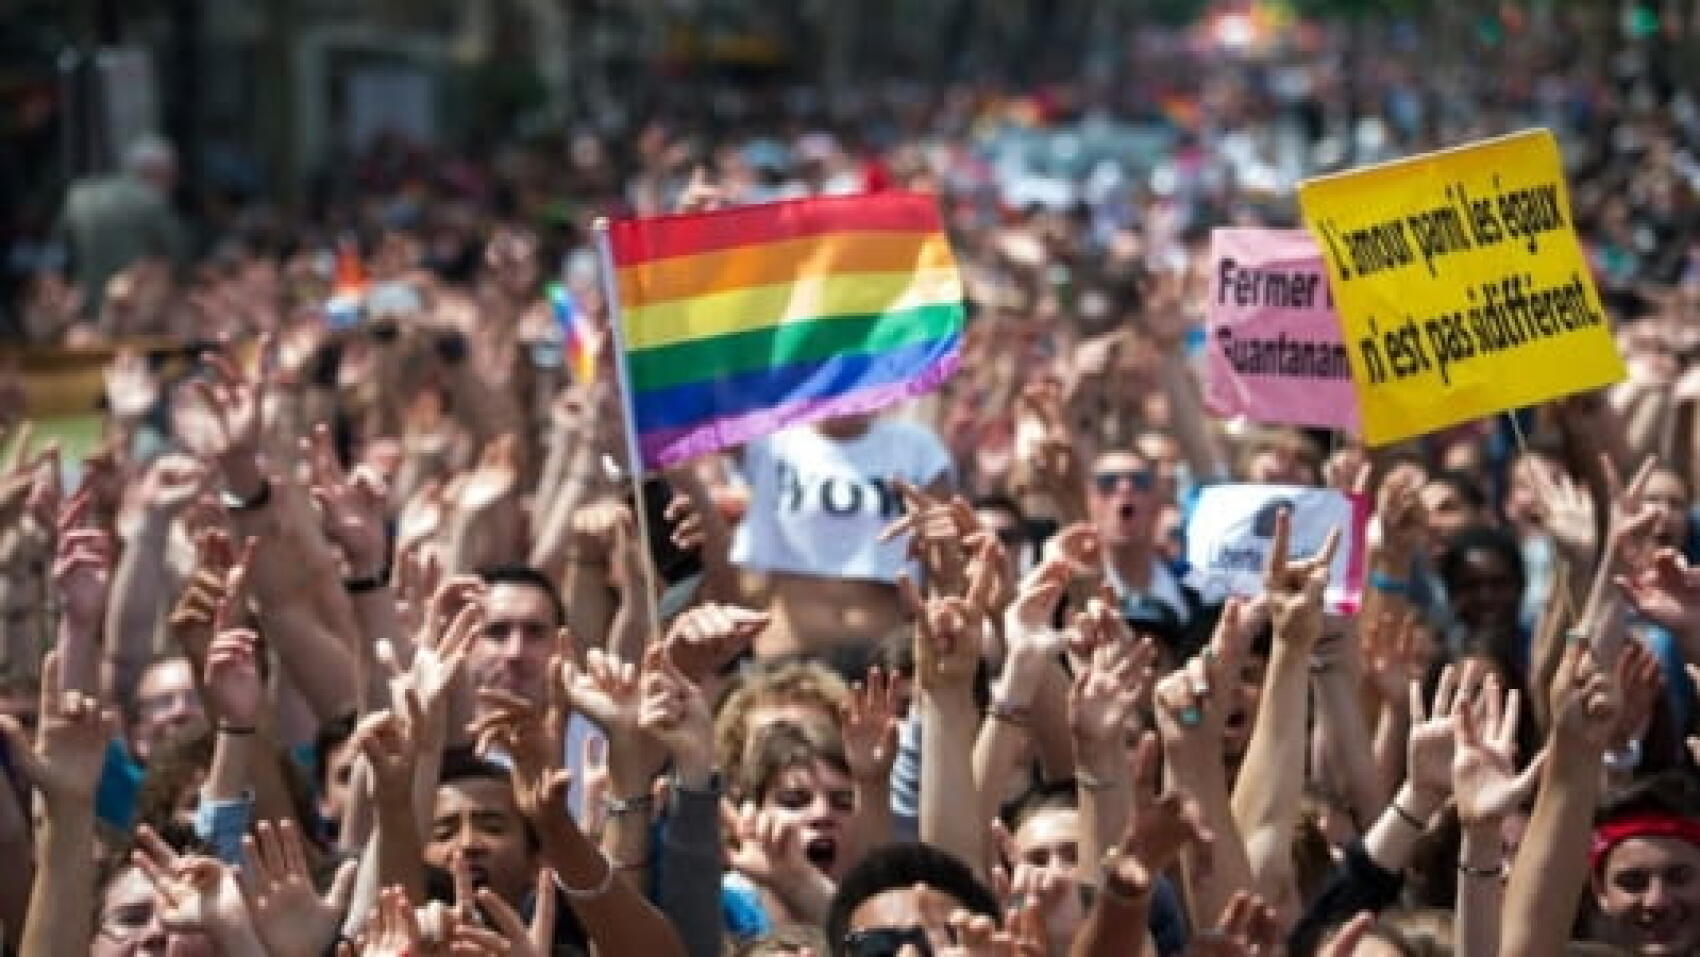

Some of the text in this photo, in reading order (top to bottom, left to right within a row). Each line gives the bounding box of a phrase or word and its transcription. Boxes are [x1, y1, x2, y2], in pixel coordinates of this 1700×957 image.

[1317, 218, 1413, 281] L'amour
[1455, 181, 1503, 247] les
[1493, 173, 1563, 253] égaux
[1217, 258, 1320, 307] Fermer
[1360, 315, 1430, 385] n'est
[1425, 311, 1474, 385] pas
